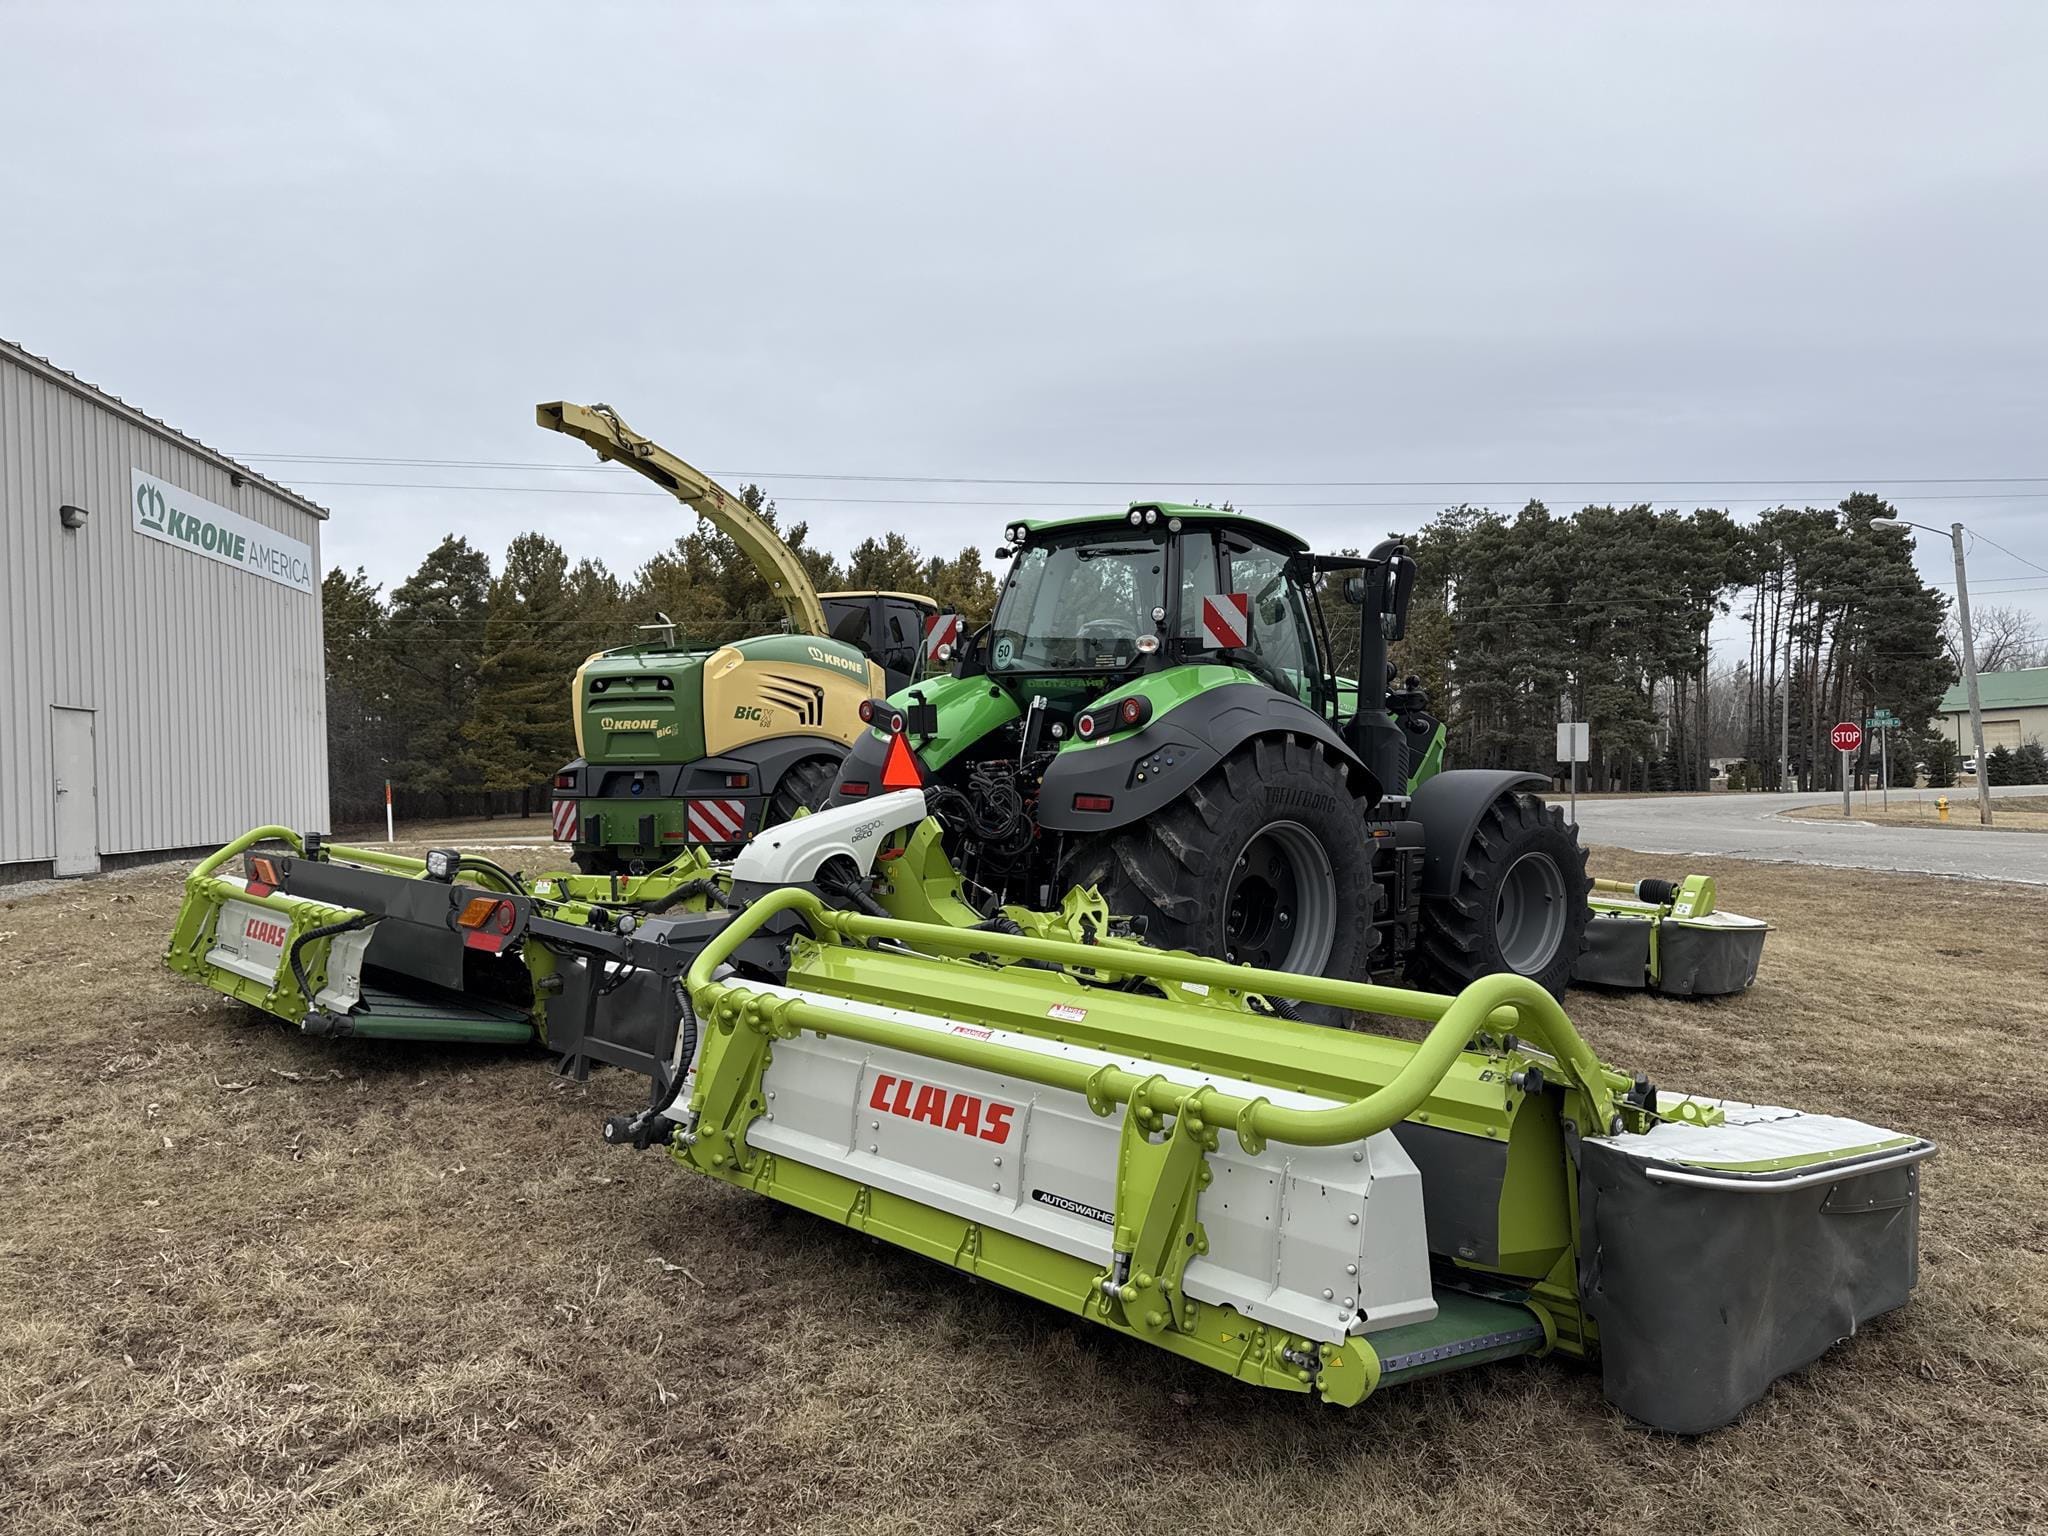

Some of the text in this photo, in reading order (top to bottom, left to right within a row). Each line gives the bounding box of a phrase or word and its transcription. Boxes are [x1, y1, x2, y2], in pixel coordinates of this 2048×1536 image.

[167, 508, 311, 587] KRONE AMERICA
[997, 644, 1010, 658] 50
[824, 653, 863, 674] KRONE
[614, 719, 659, 730] KRONE
[1833, 731, 1860, 743] STOP
[246, 918, 287, 948] CLAAS
[869, 1074, 1015, 1145] CLAAS
